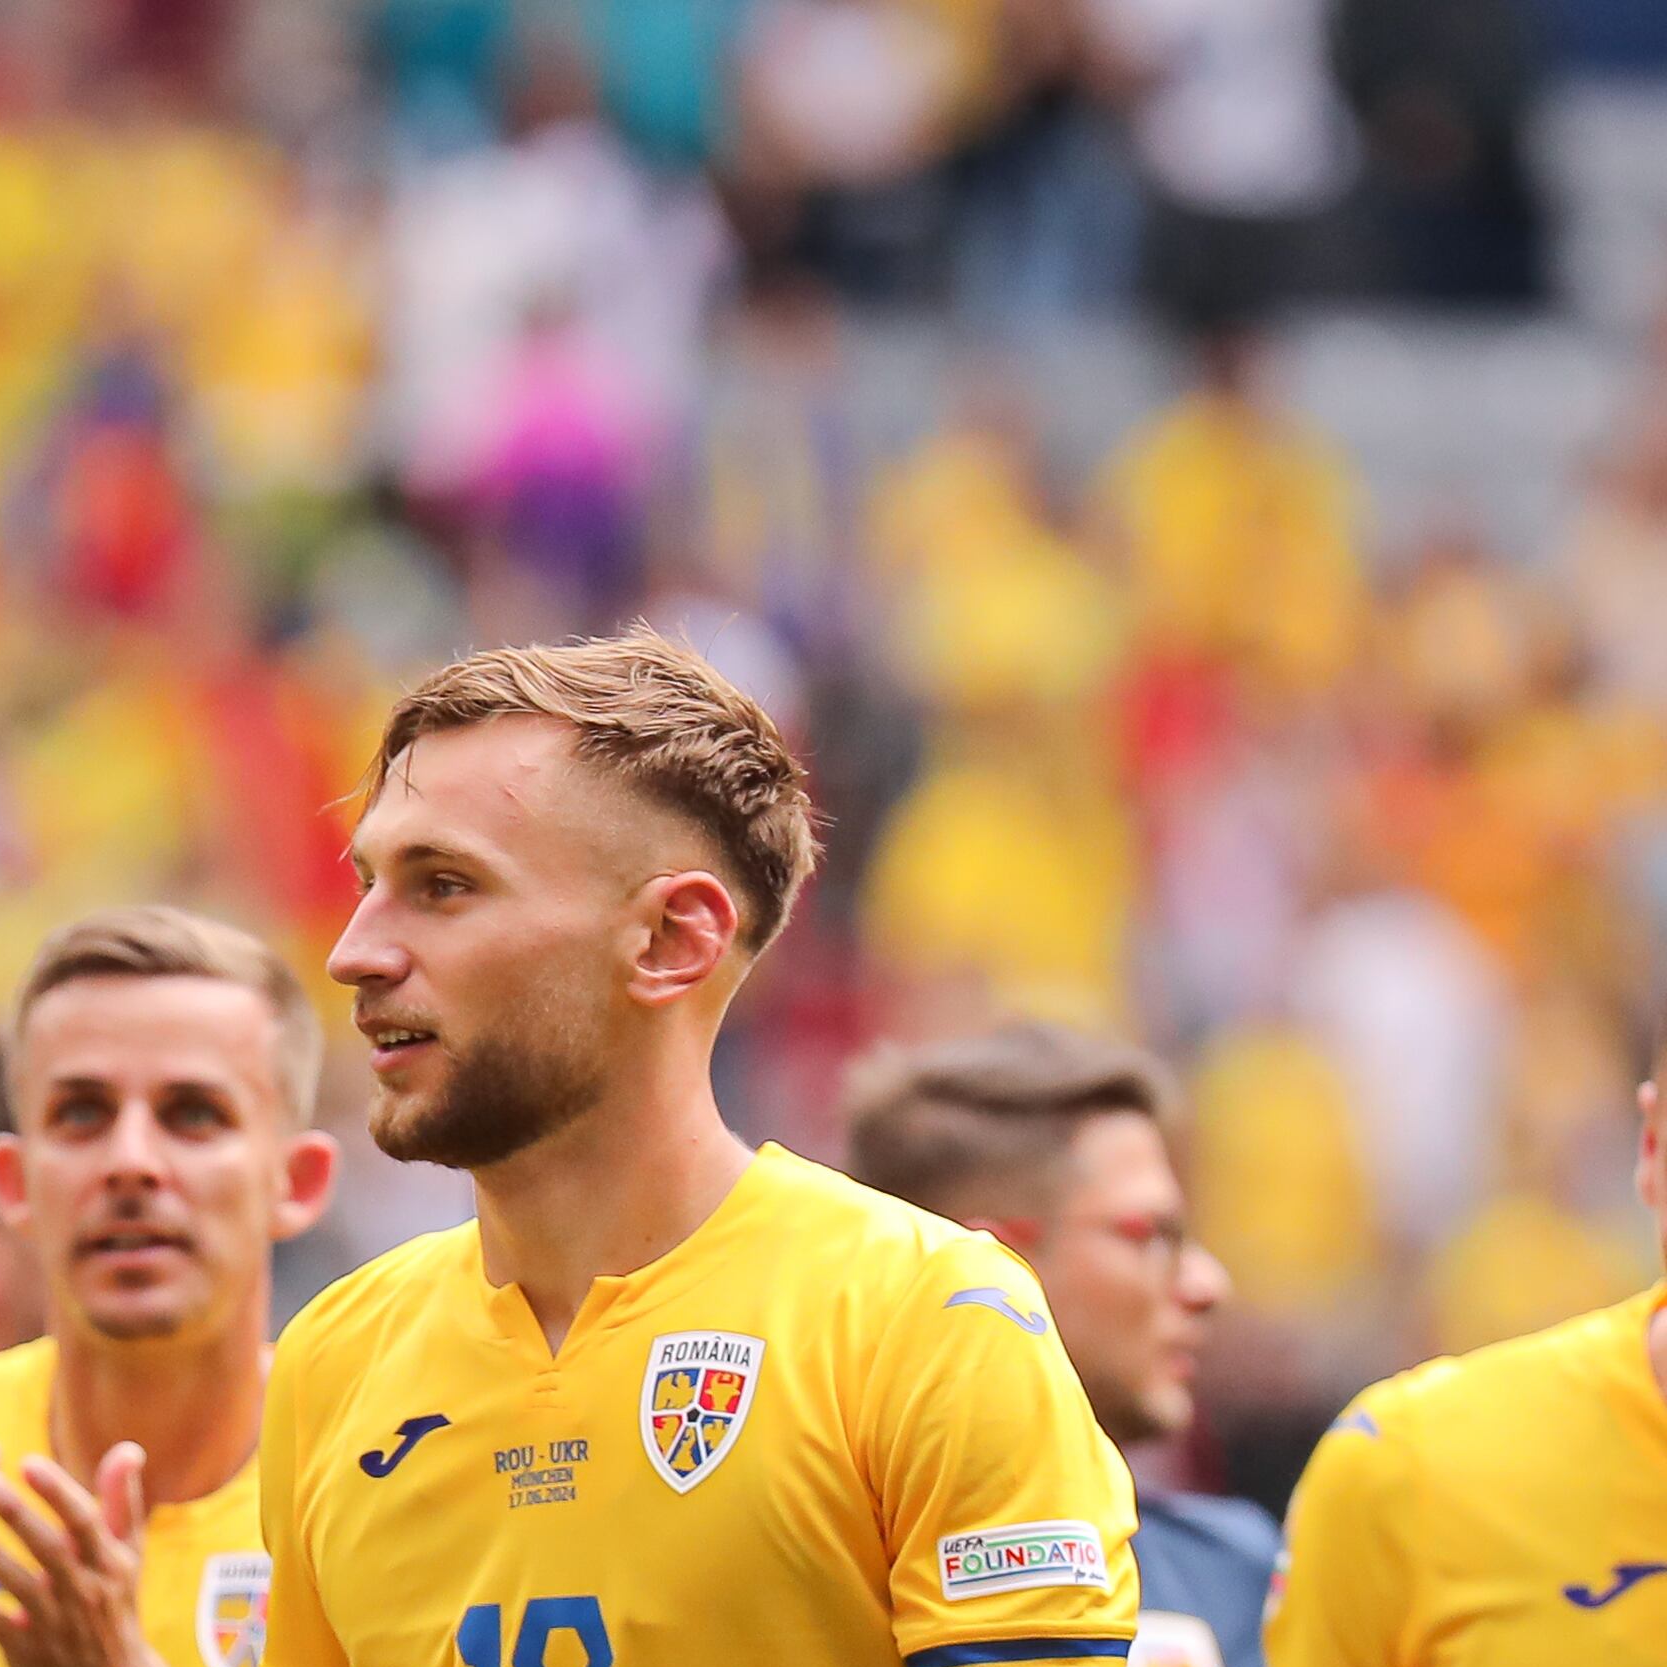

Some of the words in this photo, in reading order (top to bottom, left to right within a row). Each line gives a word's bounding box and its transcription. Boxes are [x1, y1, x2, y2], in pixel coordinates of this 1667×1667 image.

[660, 1336, 752, 1368] ROMÂNIA
[494, 1446, 534, 1474] ROU
[549, 1440, 589, 1463] UKR
[943, 1535, 988, 1554] UEFA
[945, 1541, 1097, 1579] FOUNDATIO
